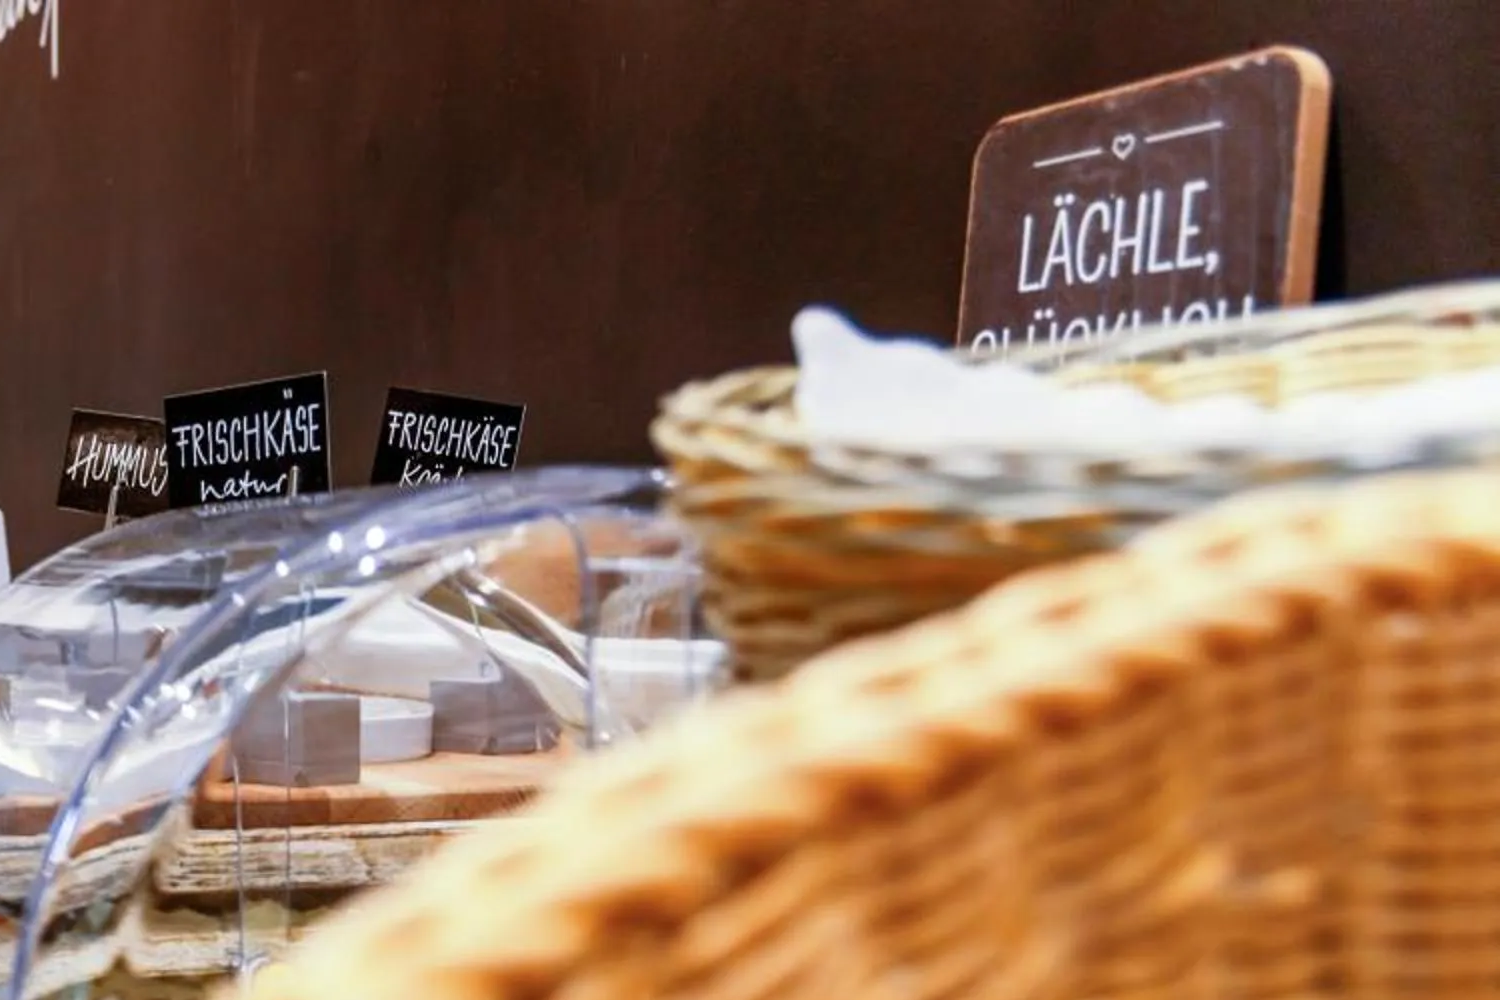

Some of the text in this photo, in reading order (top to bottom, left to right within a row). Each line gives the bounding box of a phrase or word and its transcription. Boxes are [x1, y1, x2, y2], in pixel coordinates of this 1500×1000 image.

[1017, 179, 1220, 293] LÄCHLE,
[172, 388, 321, 468] FRISCHKÄSE
[387, 409, 517, 468] FRISCHKÄSE
[66, 433, 168, 497] HUMMUS
[201, 466, 288, 502] natur
